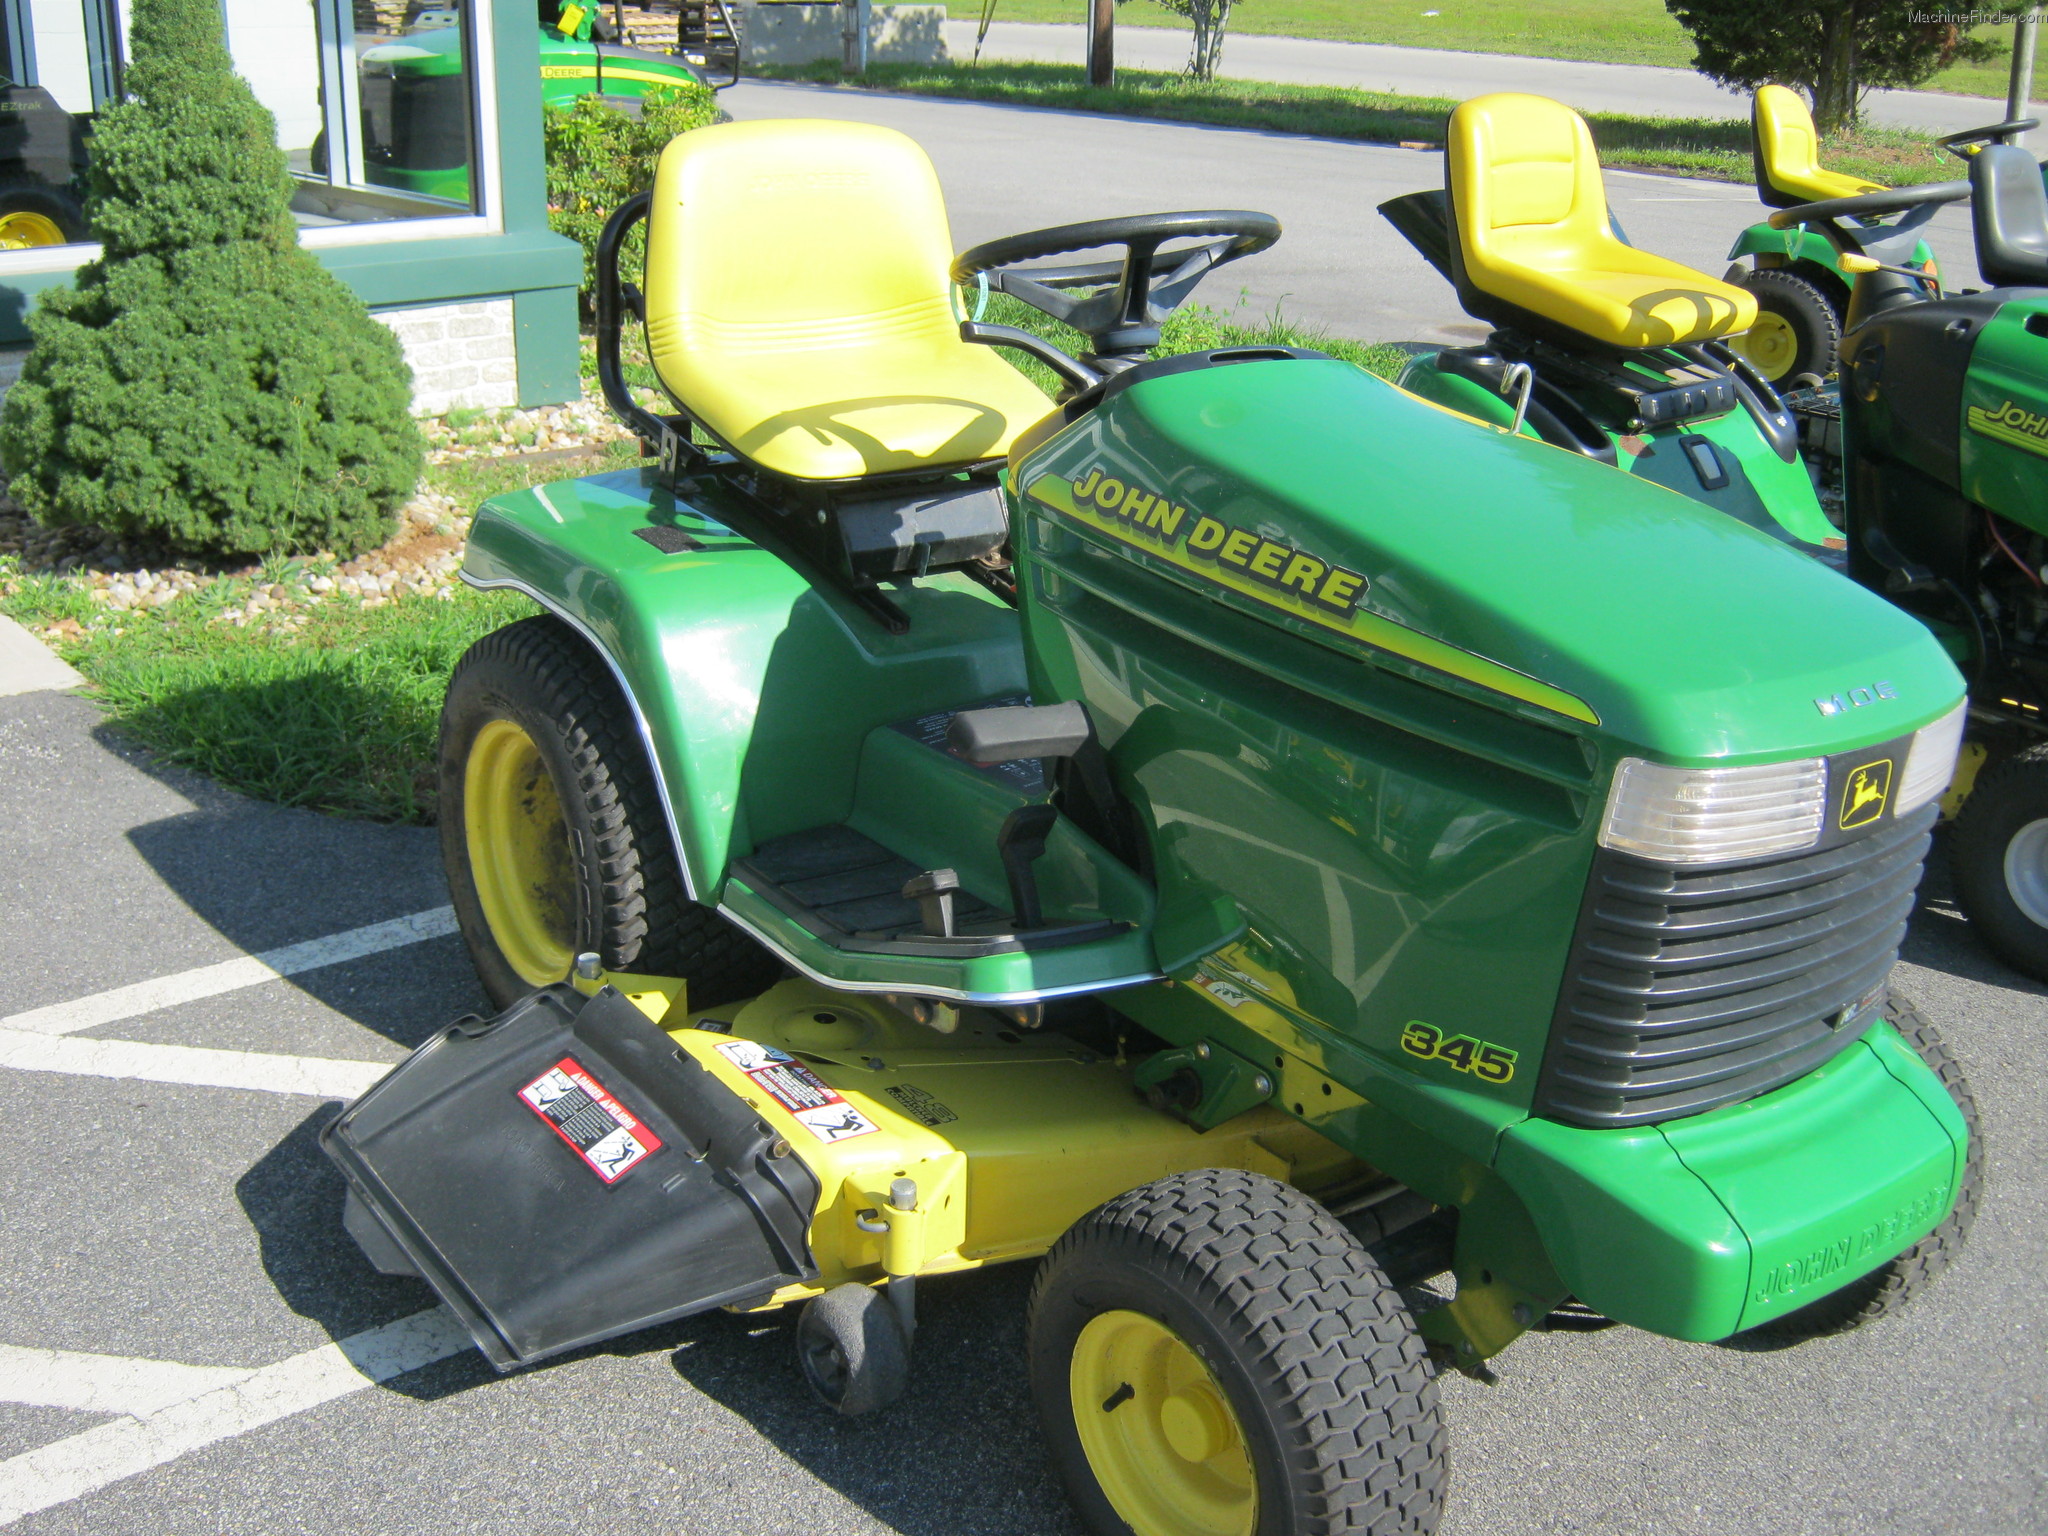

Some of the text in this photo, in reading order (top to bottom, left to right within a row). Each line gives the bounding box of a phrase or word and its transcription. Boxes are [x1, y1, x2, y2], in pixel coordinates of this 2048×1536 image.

[545, 67, 582, 78] DEERE
[1, 101, 42, 111] EZtrak
[1985, 401, 2048, 437] JOH
[1073, 469, 1367, 613] JOHN DEERE
[1814, 680, 1898, 716] MOE
[1401, 1020, 1518, 1083] 345
[576, 1075, 605, 1101] DANGER
[803, 1072, 838, 1099] DANGER
[606, 1102, 637, 1130] PELIGRO
[1755, 1236, 1852, 1304] JOHN
